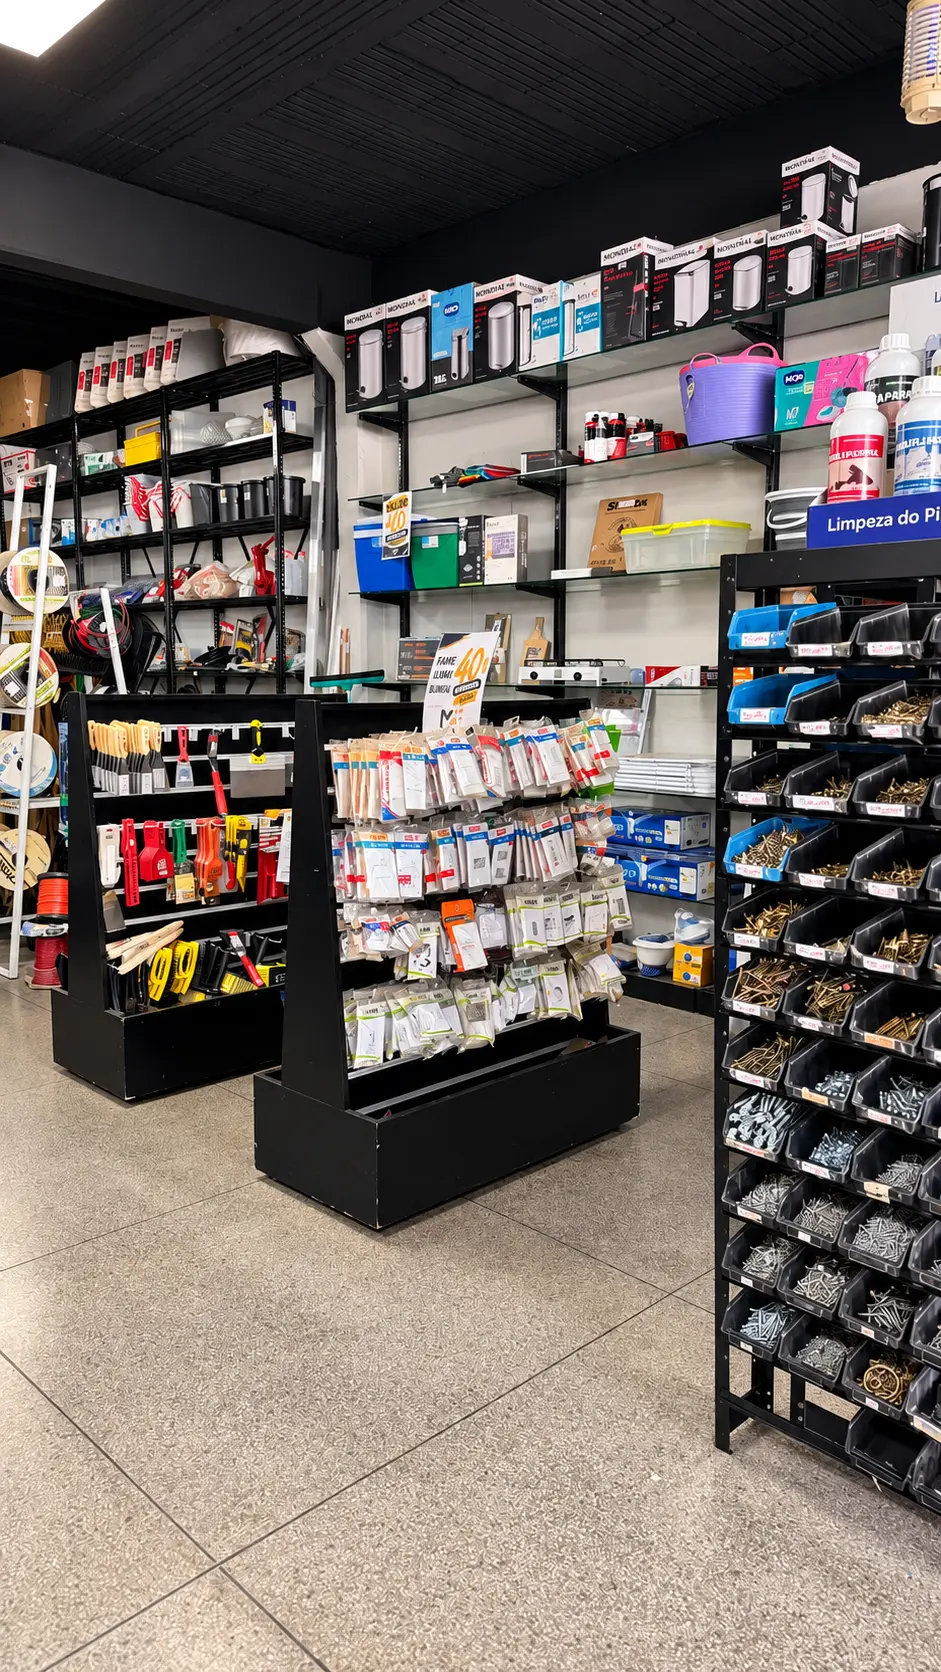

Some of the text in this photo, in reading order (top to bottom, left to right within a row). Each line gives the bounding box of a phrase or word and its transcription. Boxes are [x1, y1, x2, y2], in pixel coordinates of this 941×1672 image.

[827, 504, 941, 533] Limpeza do Pi
